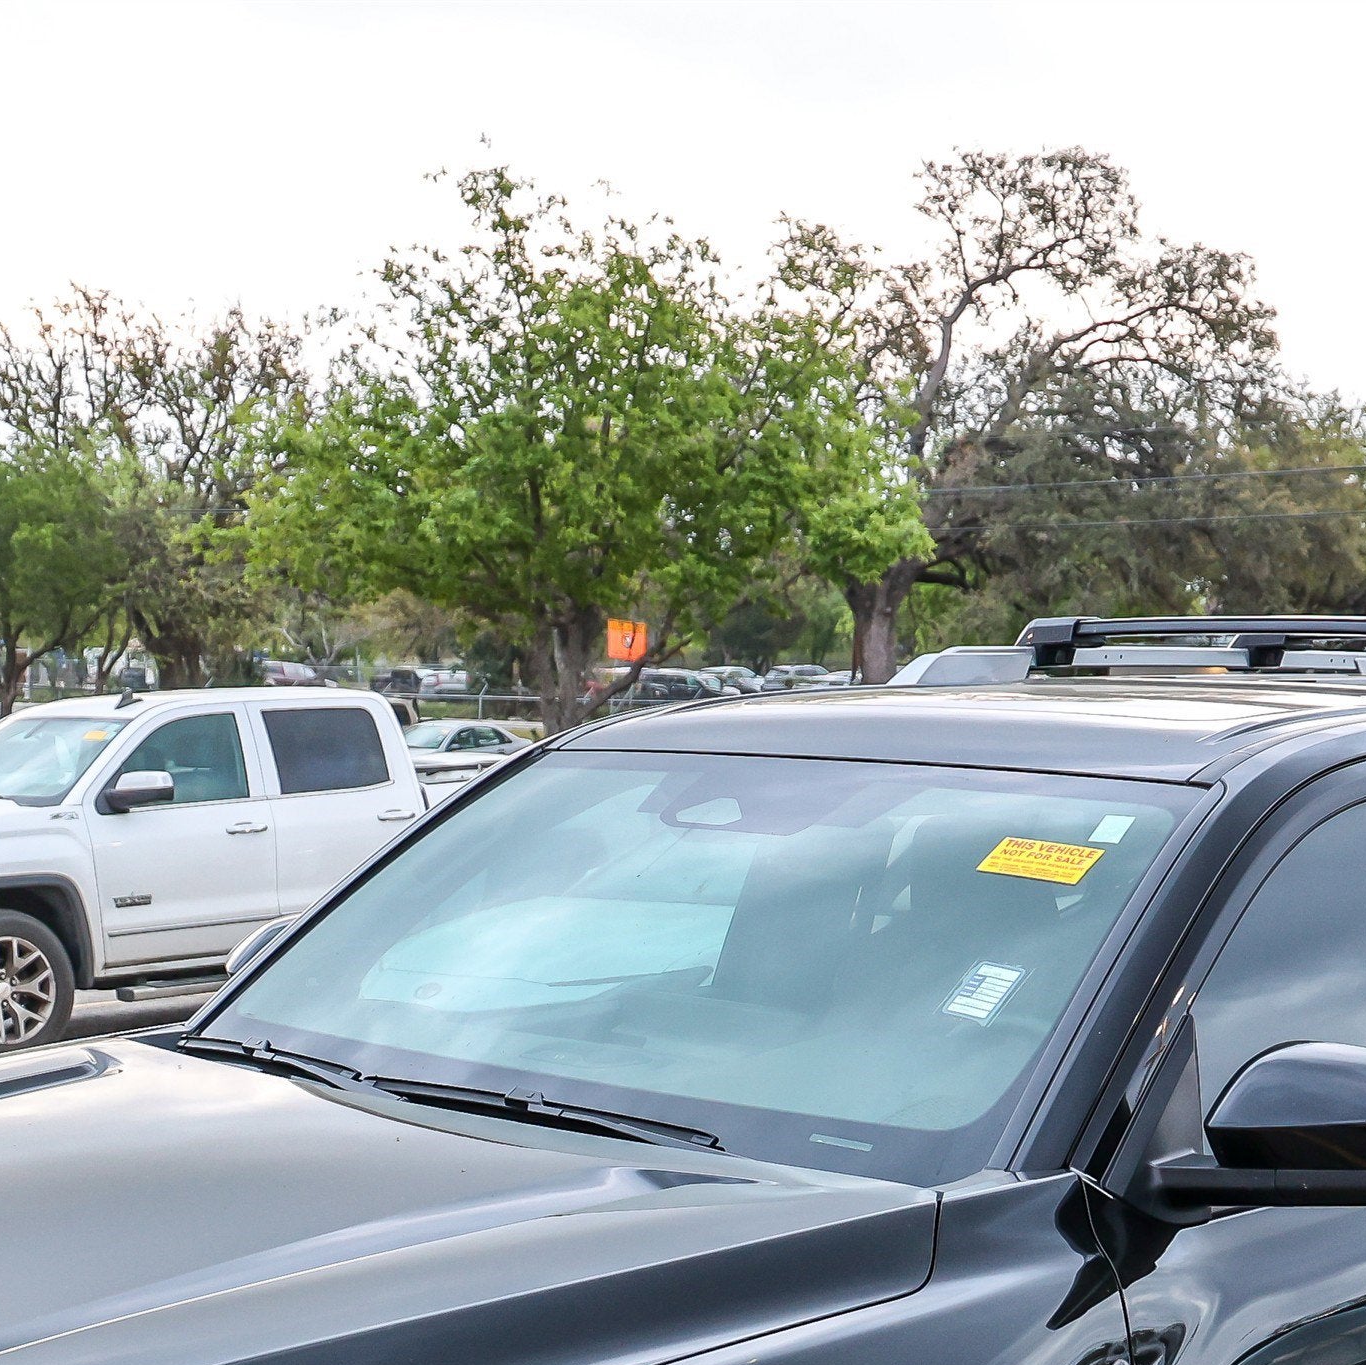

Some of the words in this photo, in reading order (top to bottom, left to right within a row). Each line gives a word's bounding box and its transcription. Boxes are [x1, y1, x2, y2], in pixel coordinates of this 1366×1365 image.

[999, 848, 1025, 856] NOT
[1025, 852, 1052, 860] FOR
[1053, 856, 1086, 865] SALE
[1004, 839, 1037, 849] THIS
[1035, 843, 1098, 858] VEHICLE
